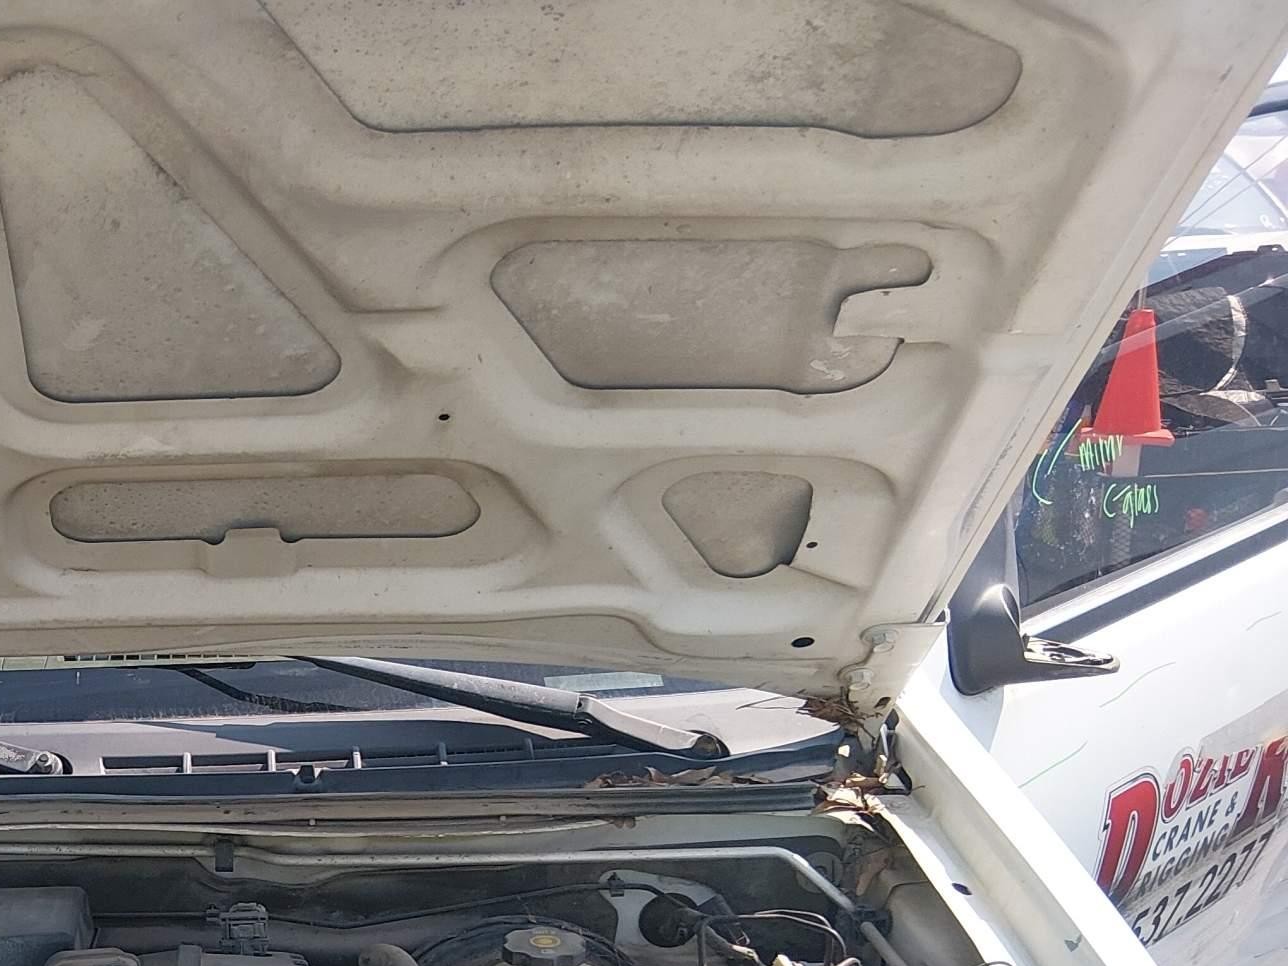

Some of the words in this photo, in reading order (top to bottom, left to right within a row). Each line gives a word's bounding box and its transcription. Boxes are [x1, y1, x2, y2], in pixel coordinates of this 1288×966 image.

[1136, 822, 1231, 898] RIGGING
[1152, 798, 1223, 862] CRANE
[1225, 791, 1240, 817] &
